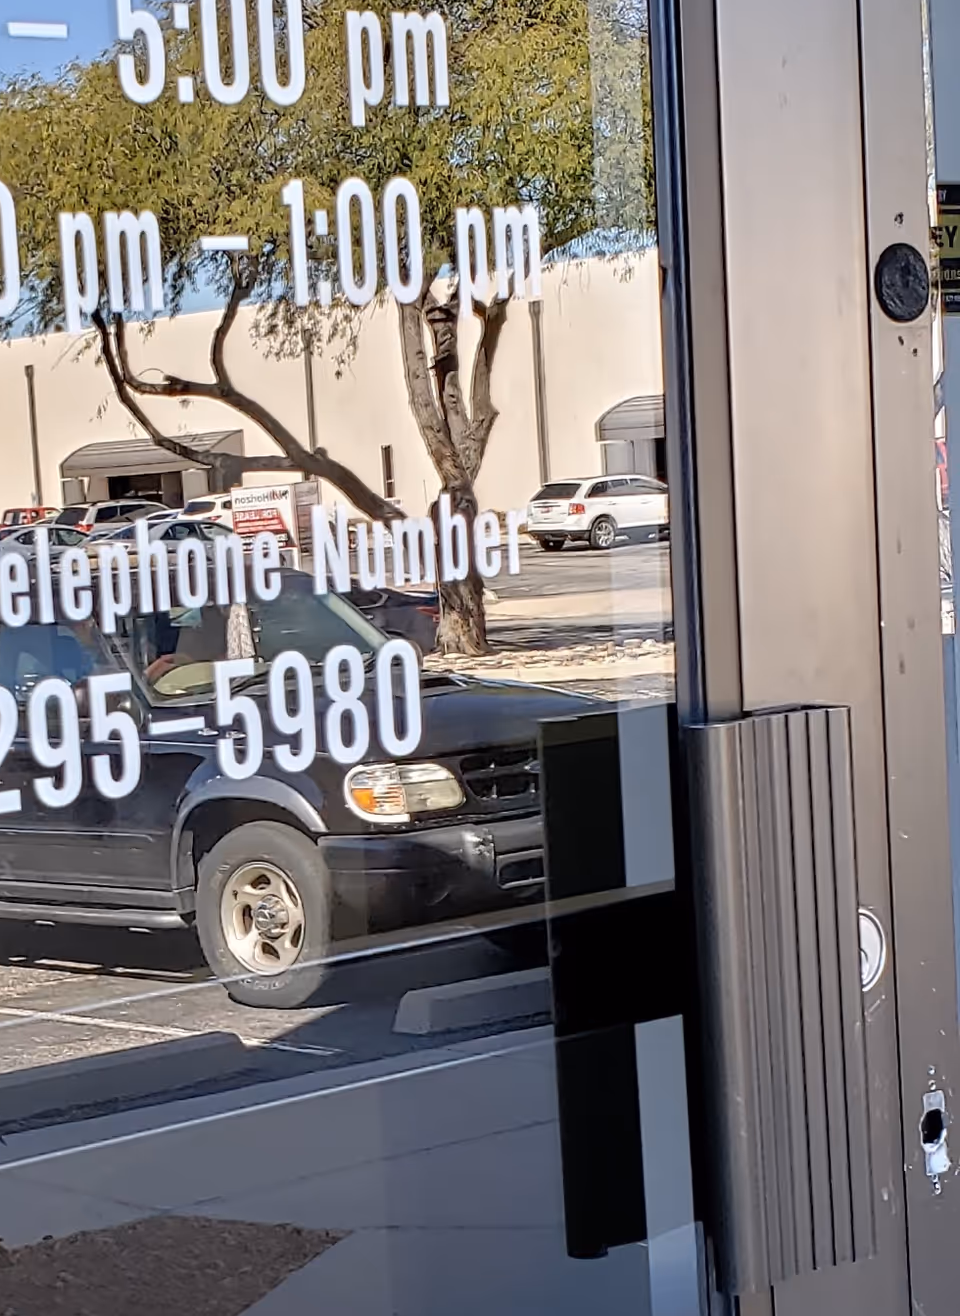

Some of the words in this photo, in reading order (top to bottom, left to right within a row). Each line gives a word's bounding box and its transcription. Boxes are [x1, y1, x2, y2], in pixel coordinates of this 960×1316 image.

[345, 8, 451, 128] pm
[59, 208, 166, 333] pm
[280, 177, 424, 308] 1:00
[455, 205, 543, 317] pm
[313, 493, 527, 597] Number
